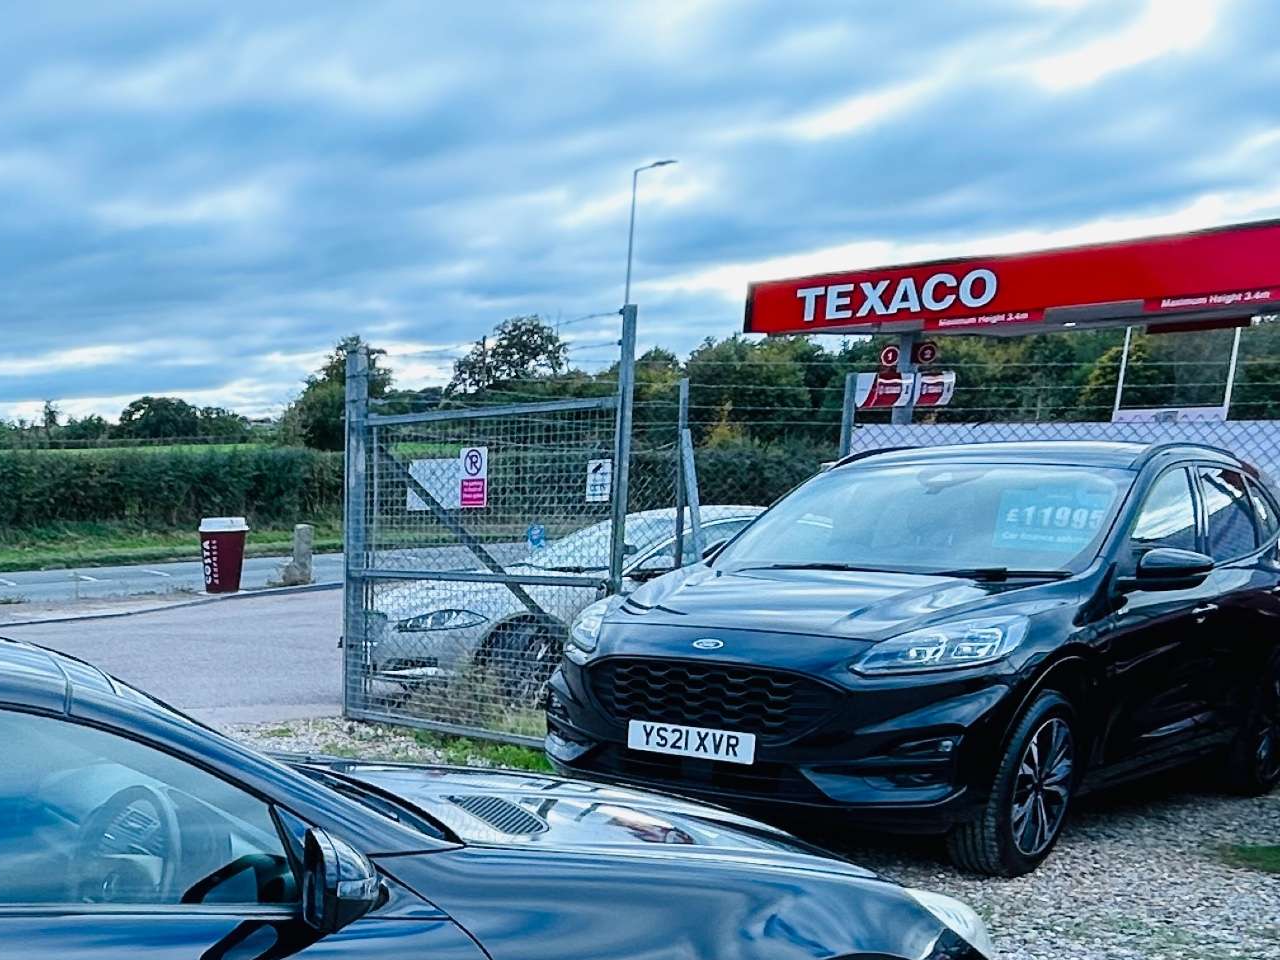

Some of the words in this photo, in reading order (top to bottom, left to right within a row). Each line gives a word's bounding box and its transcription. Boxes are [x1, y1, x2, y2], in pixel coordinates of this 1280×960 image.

[797, 268, 998, 322] TEXACO
[203, 540, 212, 585] COSTA
[642, 724, 690, 751] YS21
[695, 730, 739, 757] XVR
